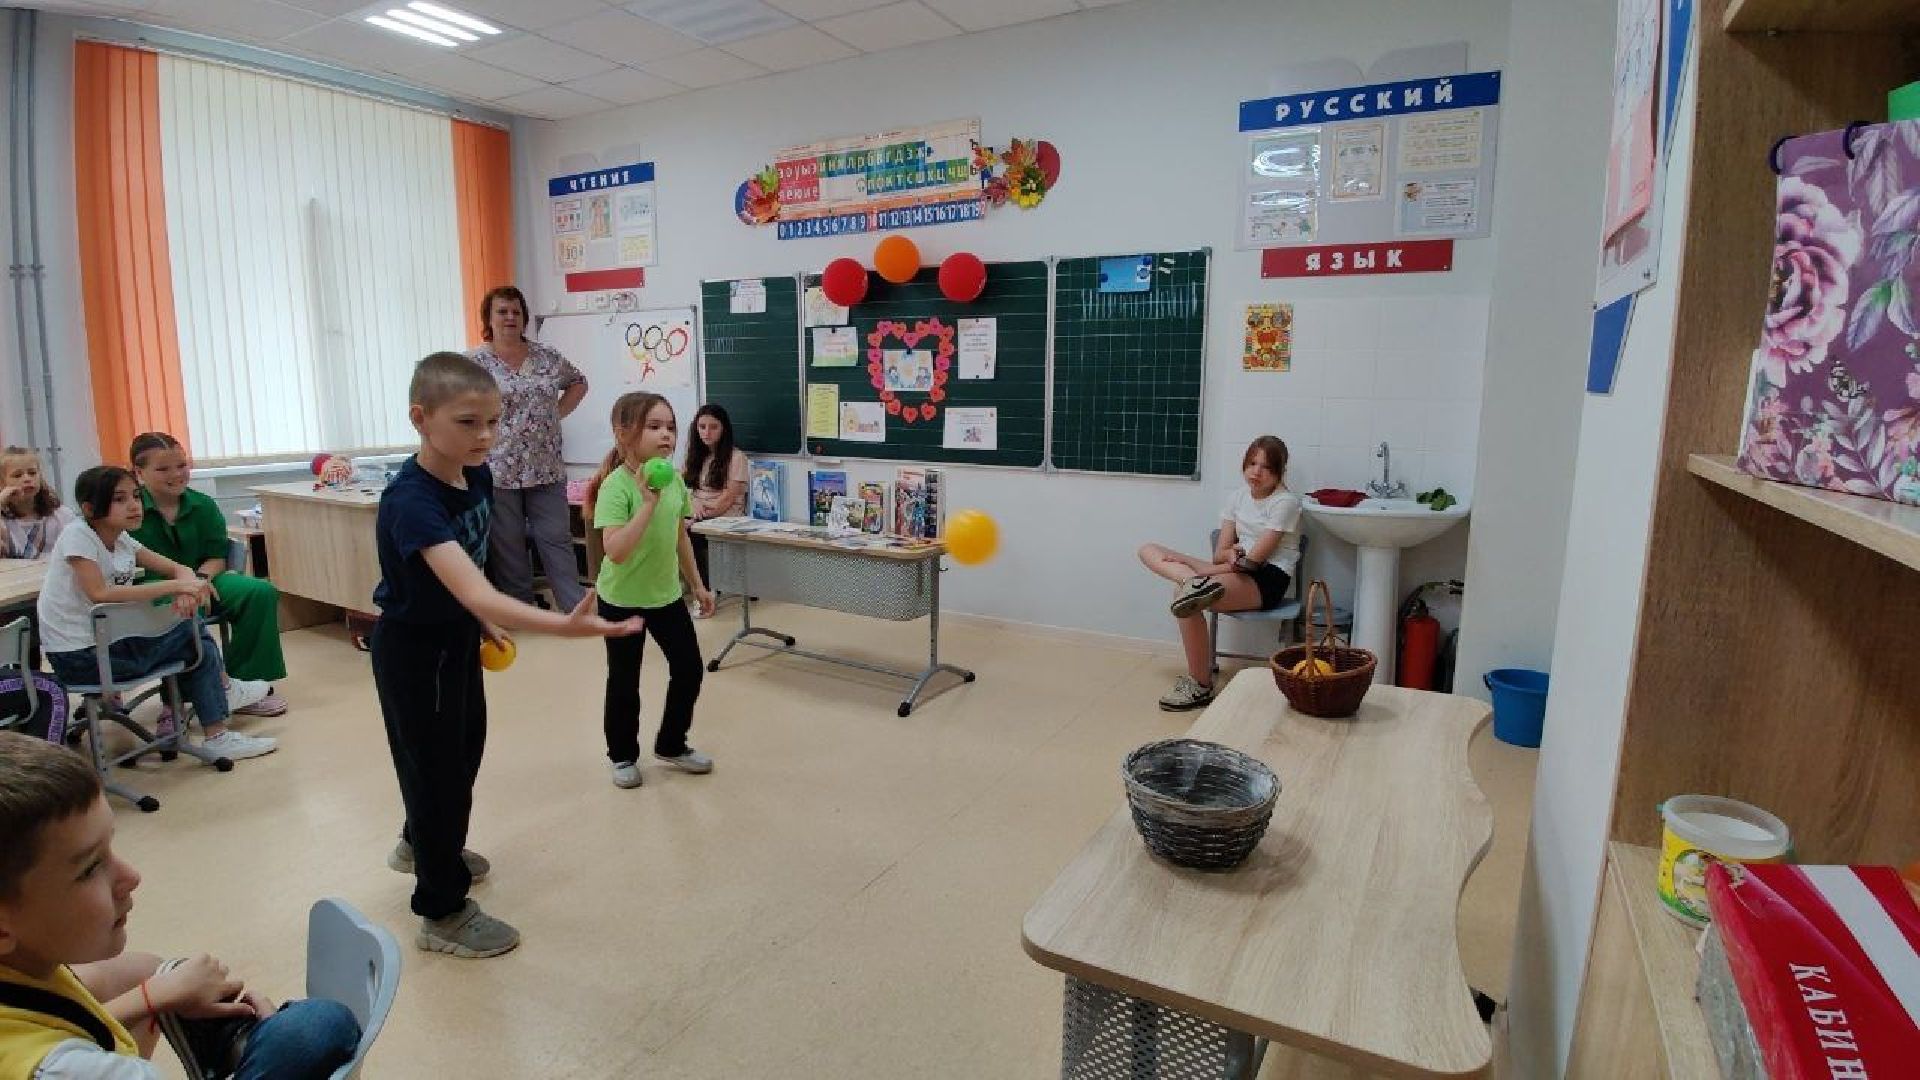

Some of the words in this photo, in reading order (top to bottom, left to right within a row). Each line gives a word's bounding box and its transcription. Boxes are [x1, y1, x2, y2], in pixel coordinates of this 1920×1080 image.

[1276, 79, 1453, 121] РУССКИЙ
[569, 171, 629, 190] ЧТЕНИЕ
[1306, 250, 1403, 271] ЯЗЫК
[1789, 962, 1869, 1080] КАБИН
